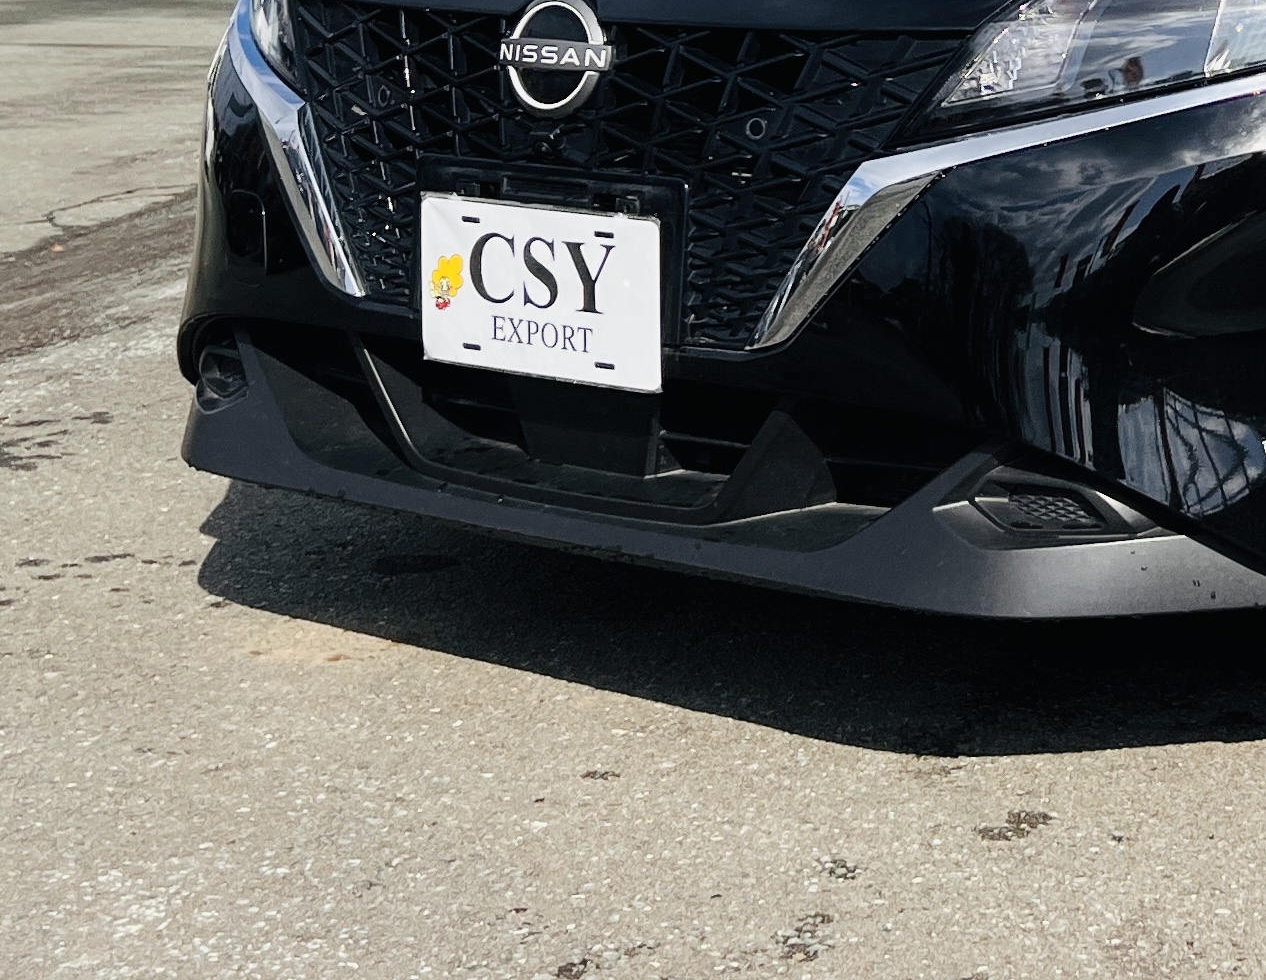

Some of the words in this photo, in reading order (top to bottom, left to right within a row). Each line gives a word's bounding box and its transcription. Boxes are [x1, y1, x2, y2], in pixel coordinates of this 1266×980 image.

[500, 42, 606, 68] NISSAN
[469, 231, 616, 315] CSY
[491, 314, 594, 354] EXPORT
